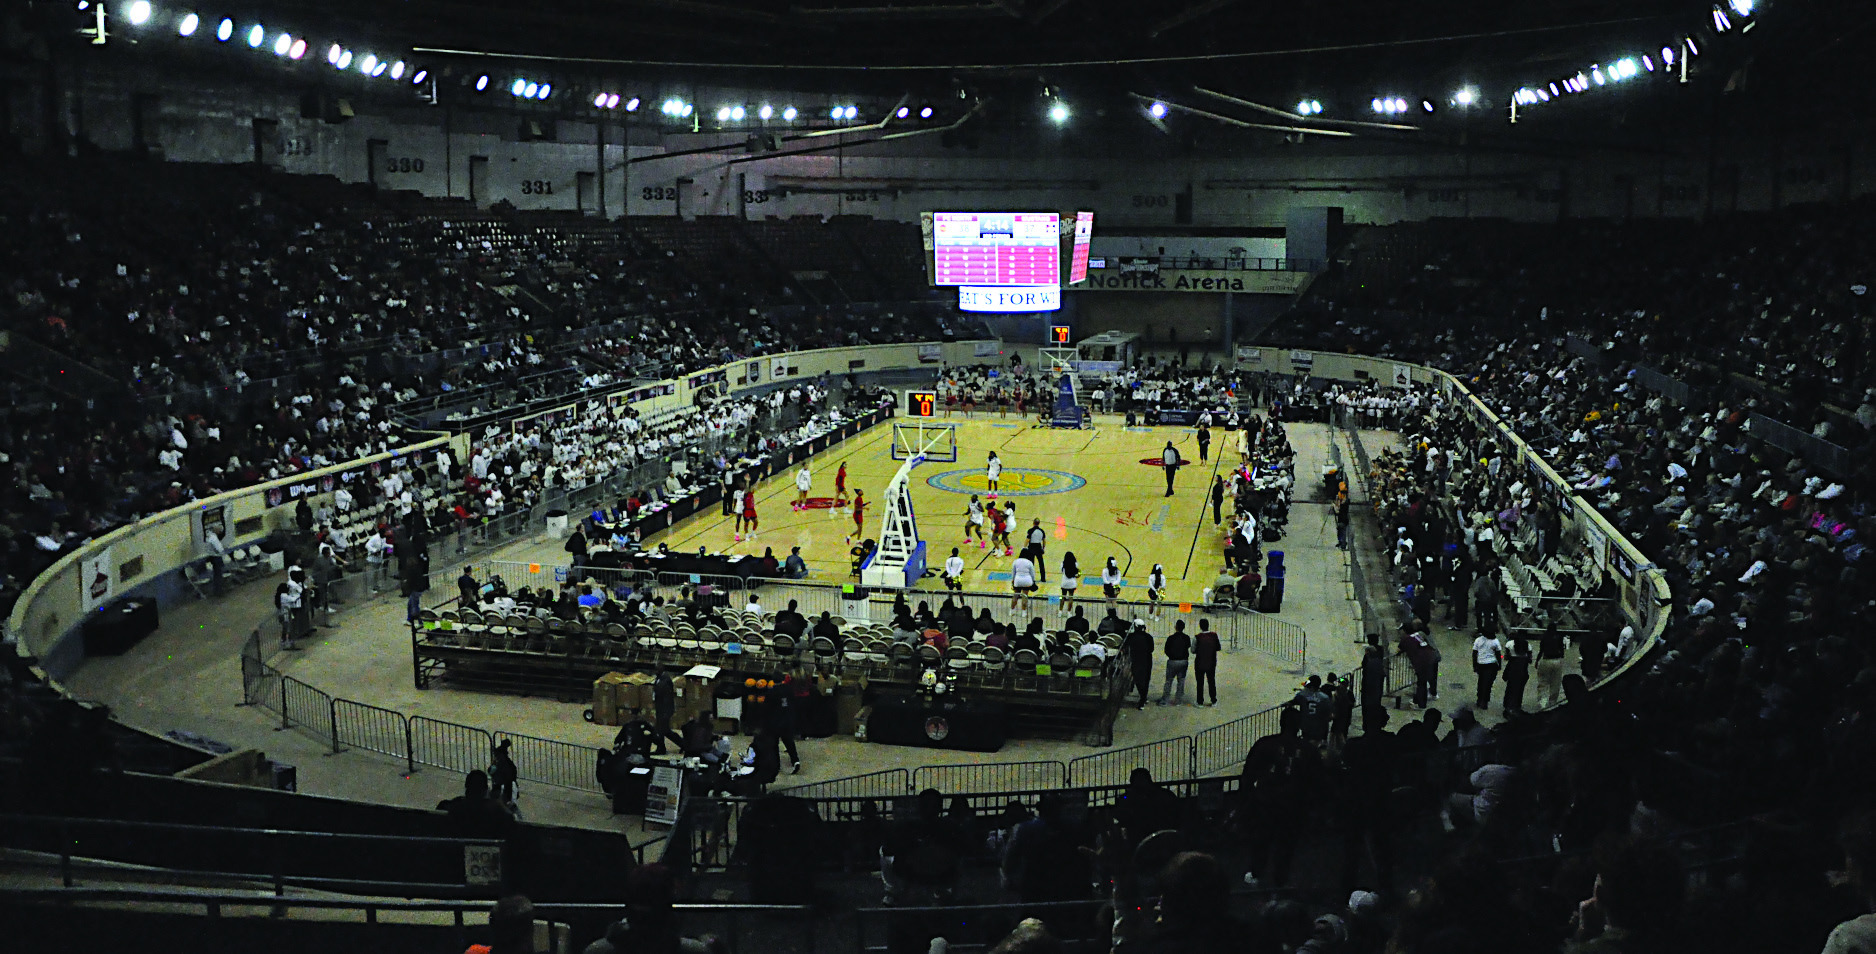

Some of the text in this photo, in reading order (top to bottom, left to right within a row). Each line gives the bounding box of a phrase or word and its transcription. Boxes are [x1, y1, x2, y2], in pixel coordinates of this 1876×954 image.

[387, 157, 424, 173] 330
[521, 180, 553, 195] 331
[642, 186, 676, 201] 332
[1089, 273, 1166, 289] Norick
[1174, 275, 1244, 291] Arena
[999, 292, 1036, 305] FOR
[1308, 702, 1317, 715] 5
